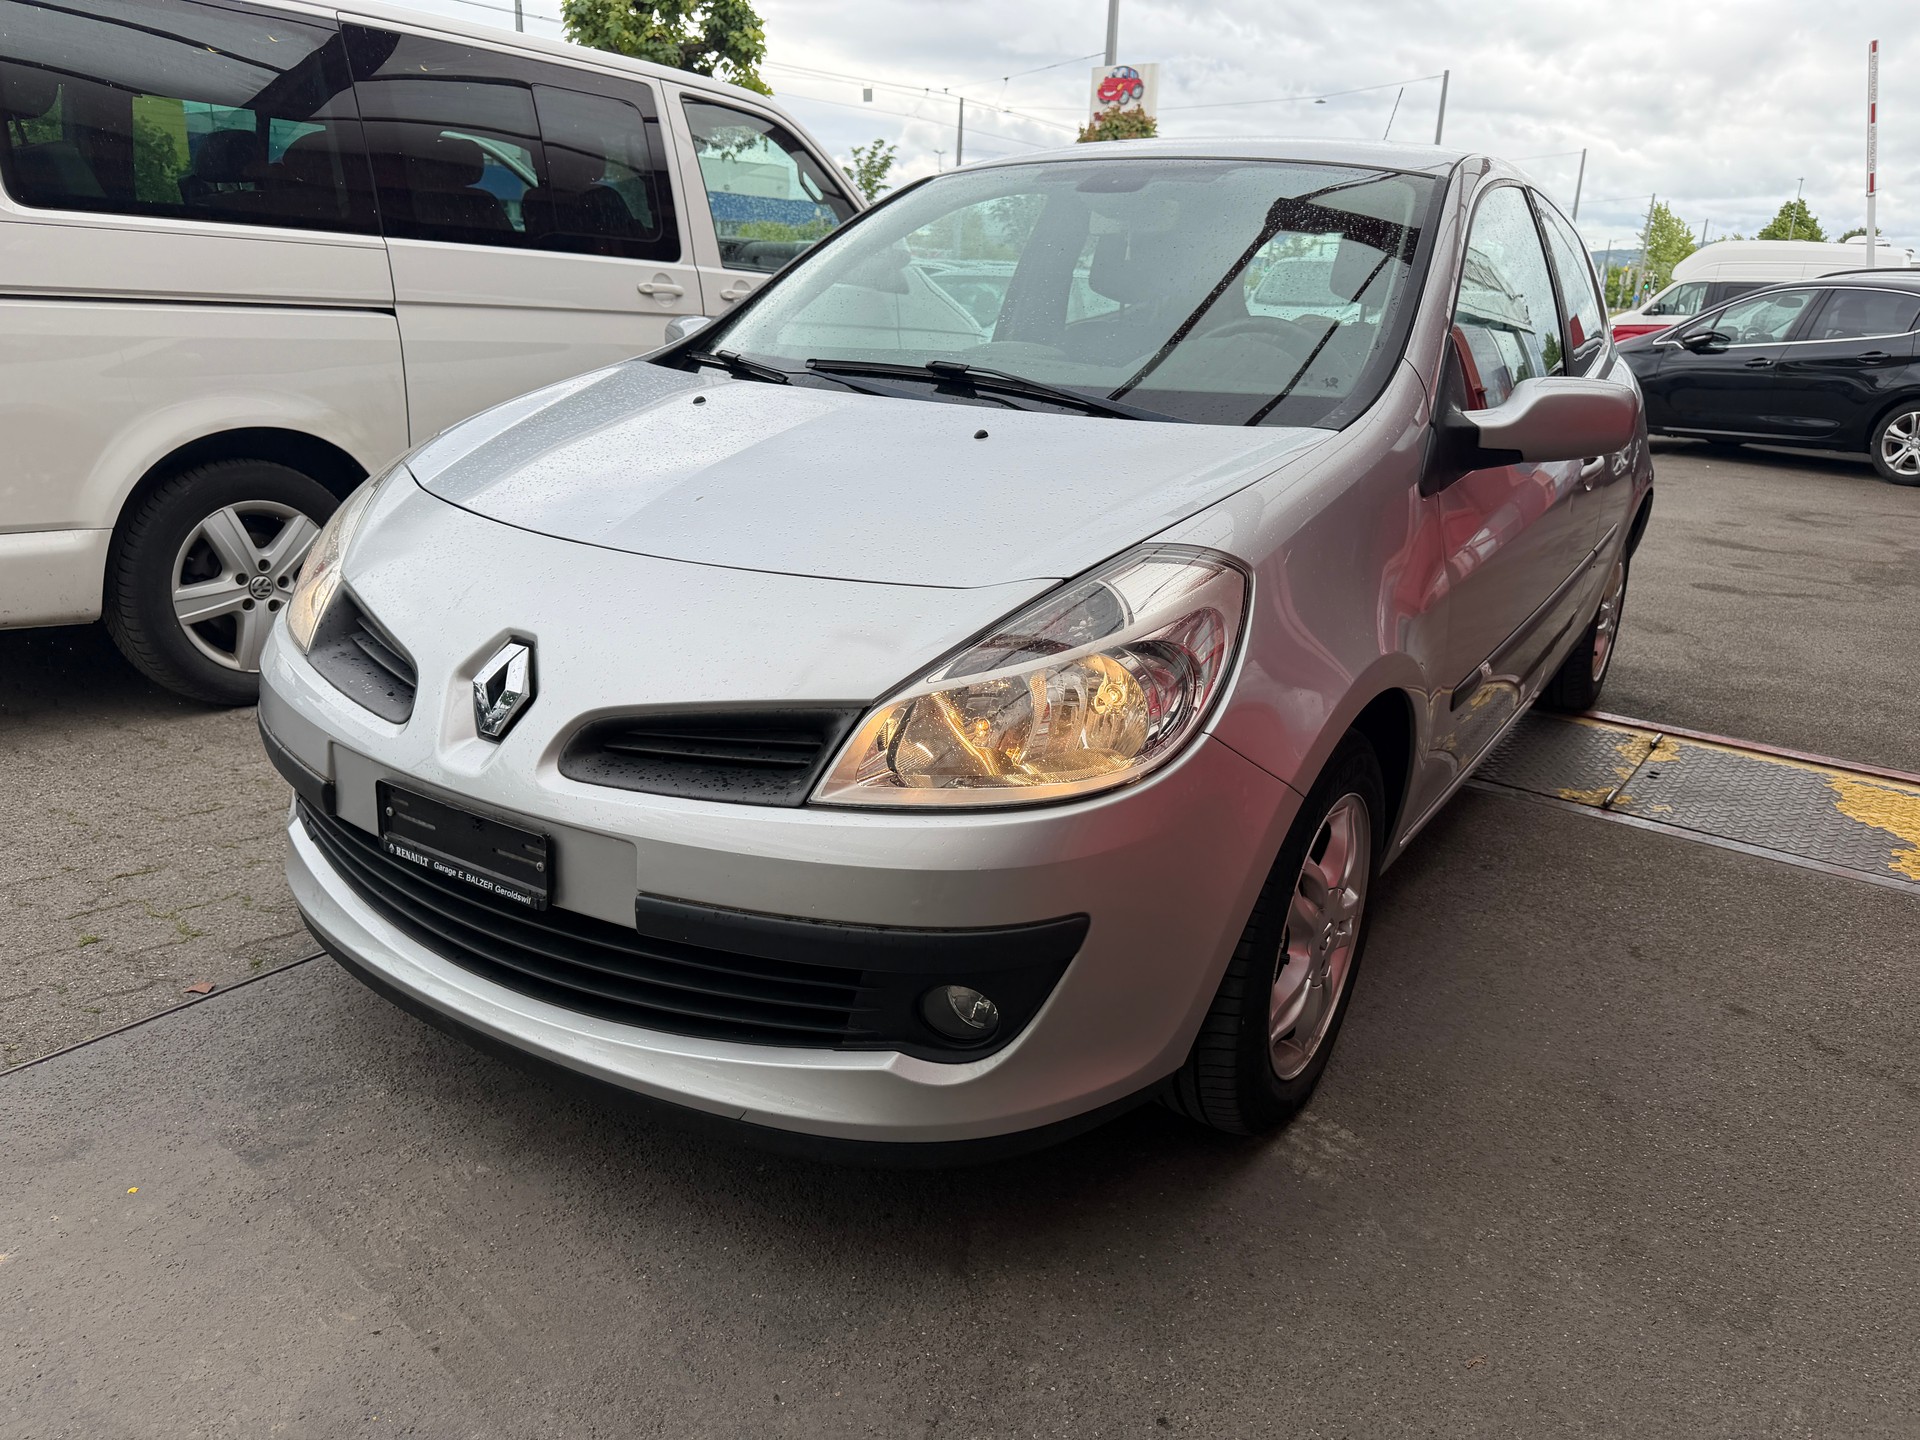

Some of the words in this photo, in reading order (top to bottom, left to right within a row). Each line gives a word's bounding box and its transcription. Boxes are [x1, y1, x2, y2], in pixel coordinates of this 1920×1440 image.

[396, 846, 429, 867] RENAULT
[433, 861, 457, 877] Garage
[458, 870, 465, 880] E.
[465, 873, 494, 891] BALZER
[494, 885, 532, 905] Geroldswil
